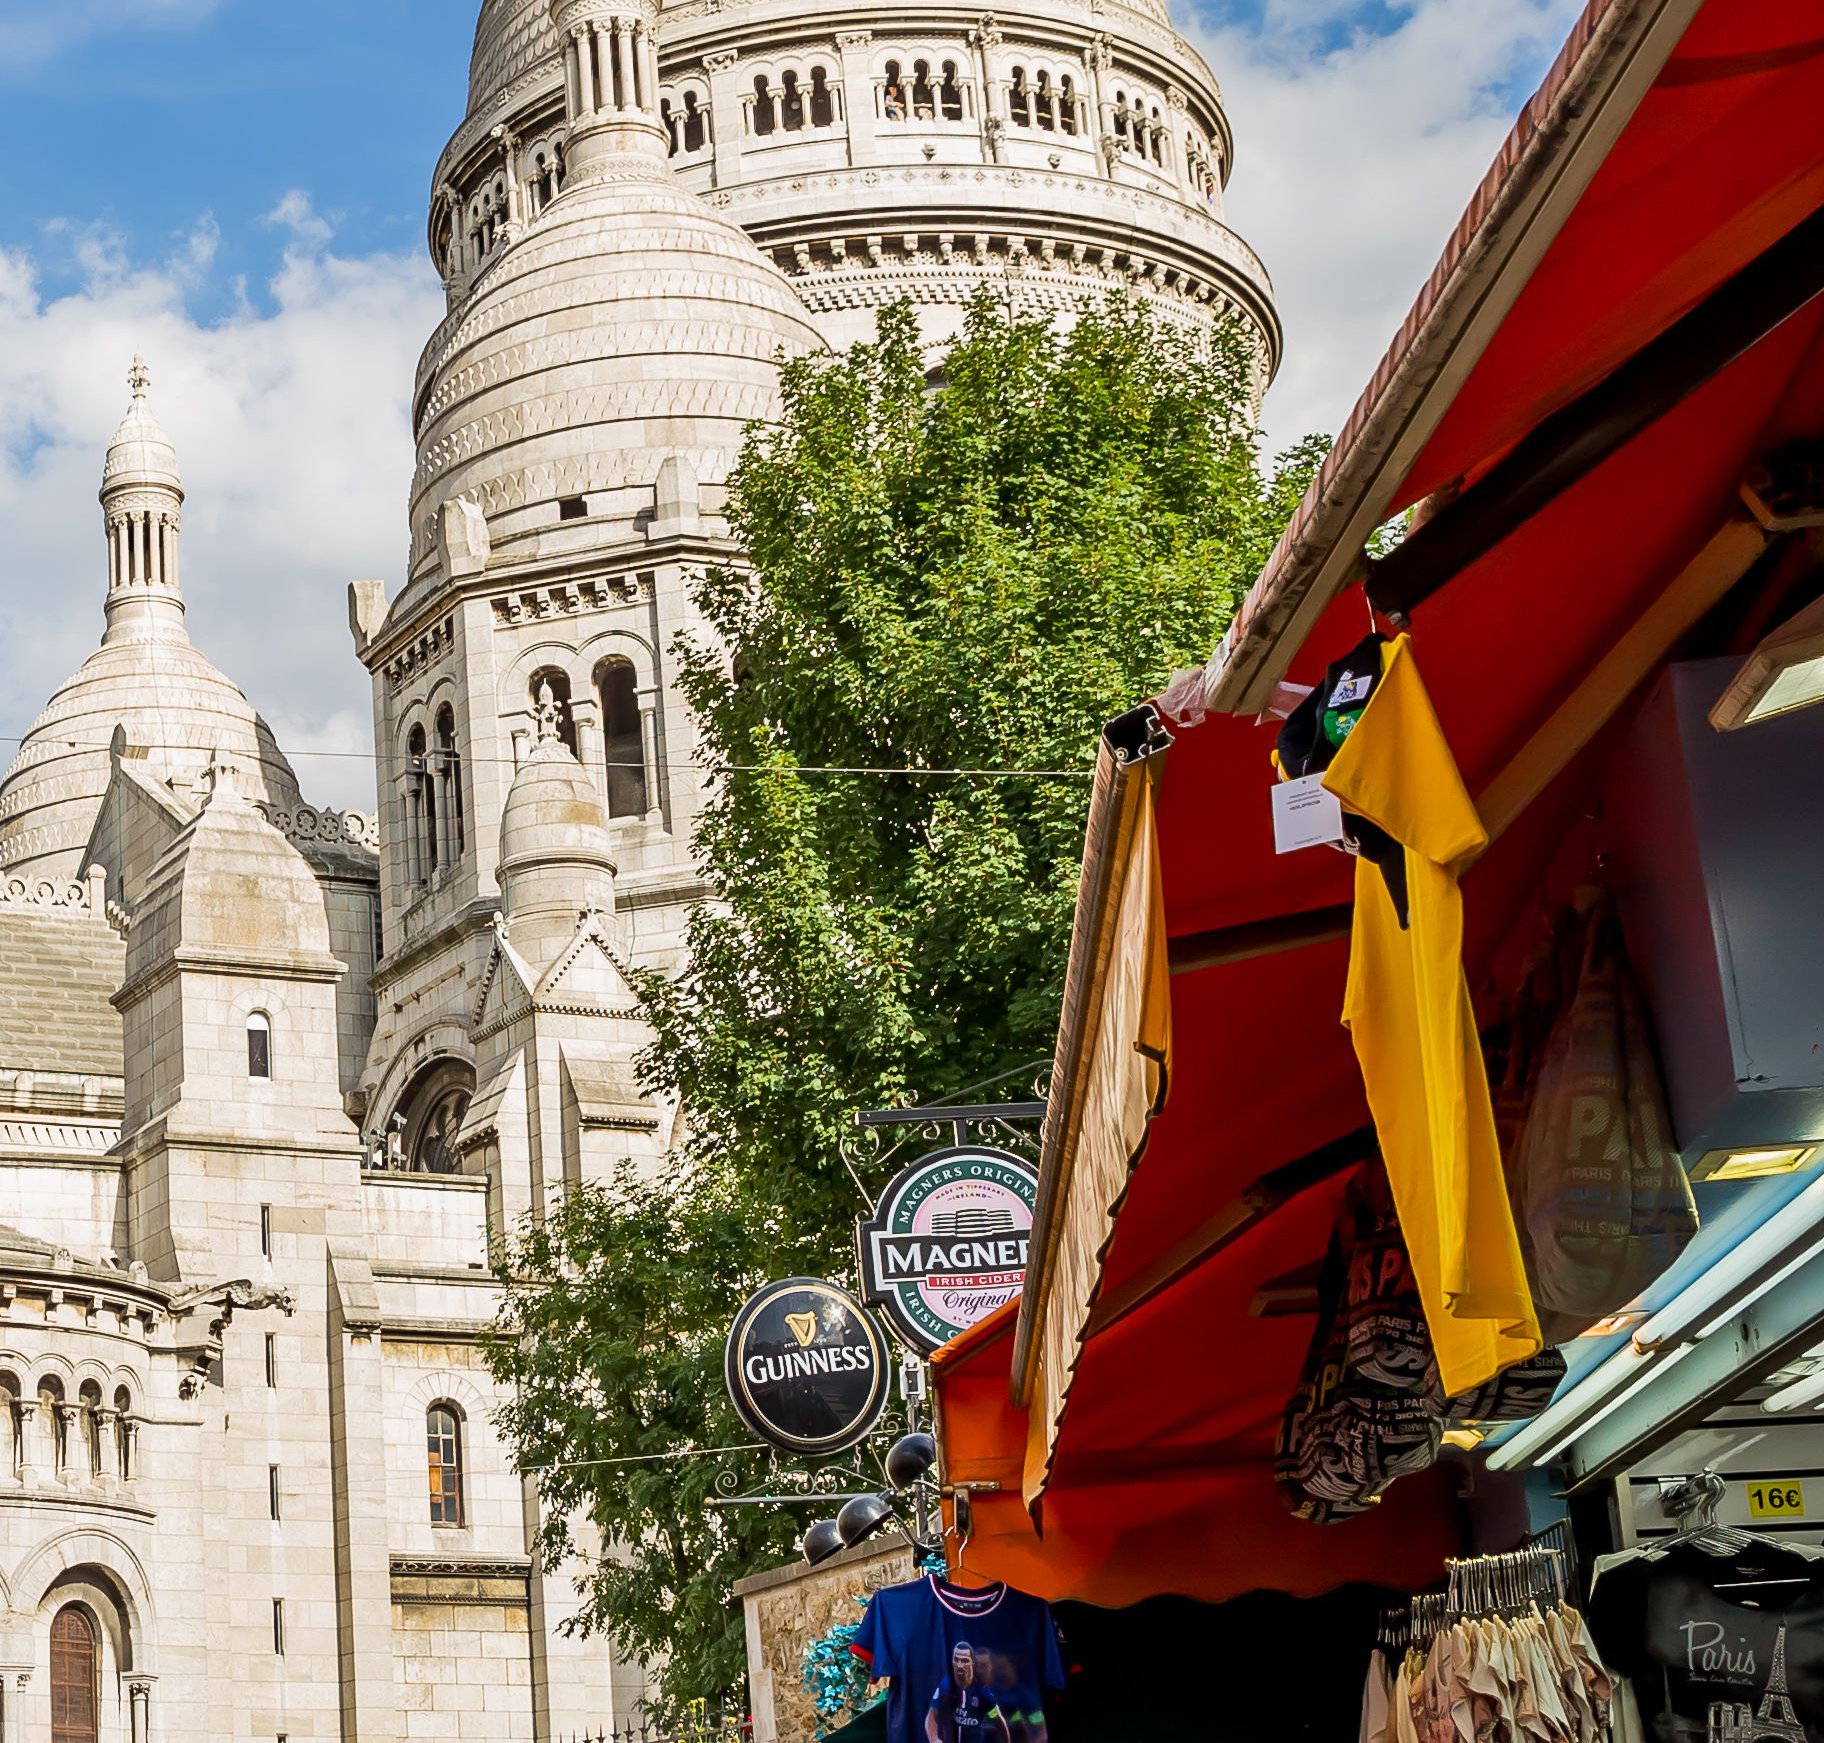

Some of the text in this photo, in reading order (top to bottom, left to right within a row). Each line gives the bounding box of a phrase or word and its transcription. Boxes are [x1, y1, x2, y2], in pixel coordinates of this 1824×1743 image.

[899, 1166, 963, 1224] MAGNERS
[935, 1272, 1021, 1286] IRISH CIDER
[905, 1291, 942, 1333] IRISH
[942, 1288, 1016, 1314] Original
[746, 1345, 870, 1384] GUINNESS
[1752, 1485, 1801, 1510] 16€
[1678, 1620, 1756, 1675] Paris
